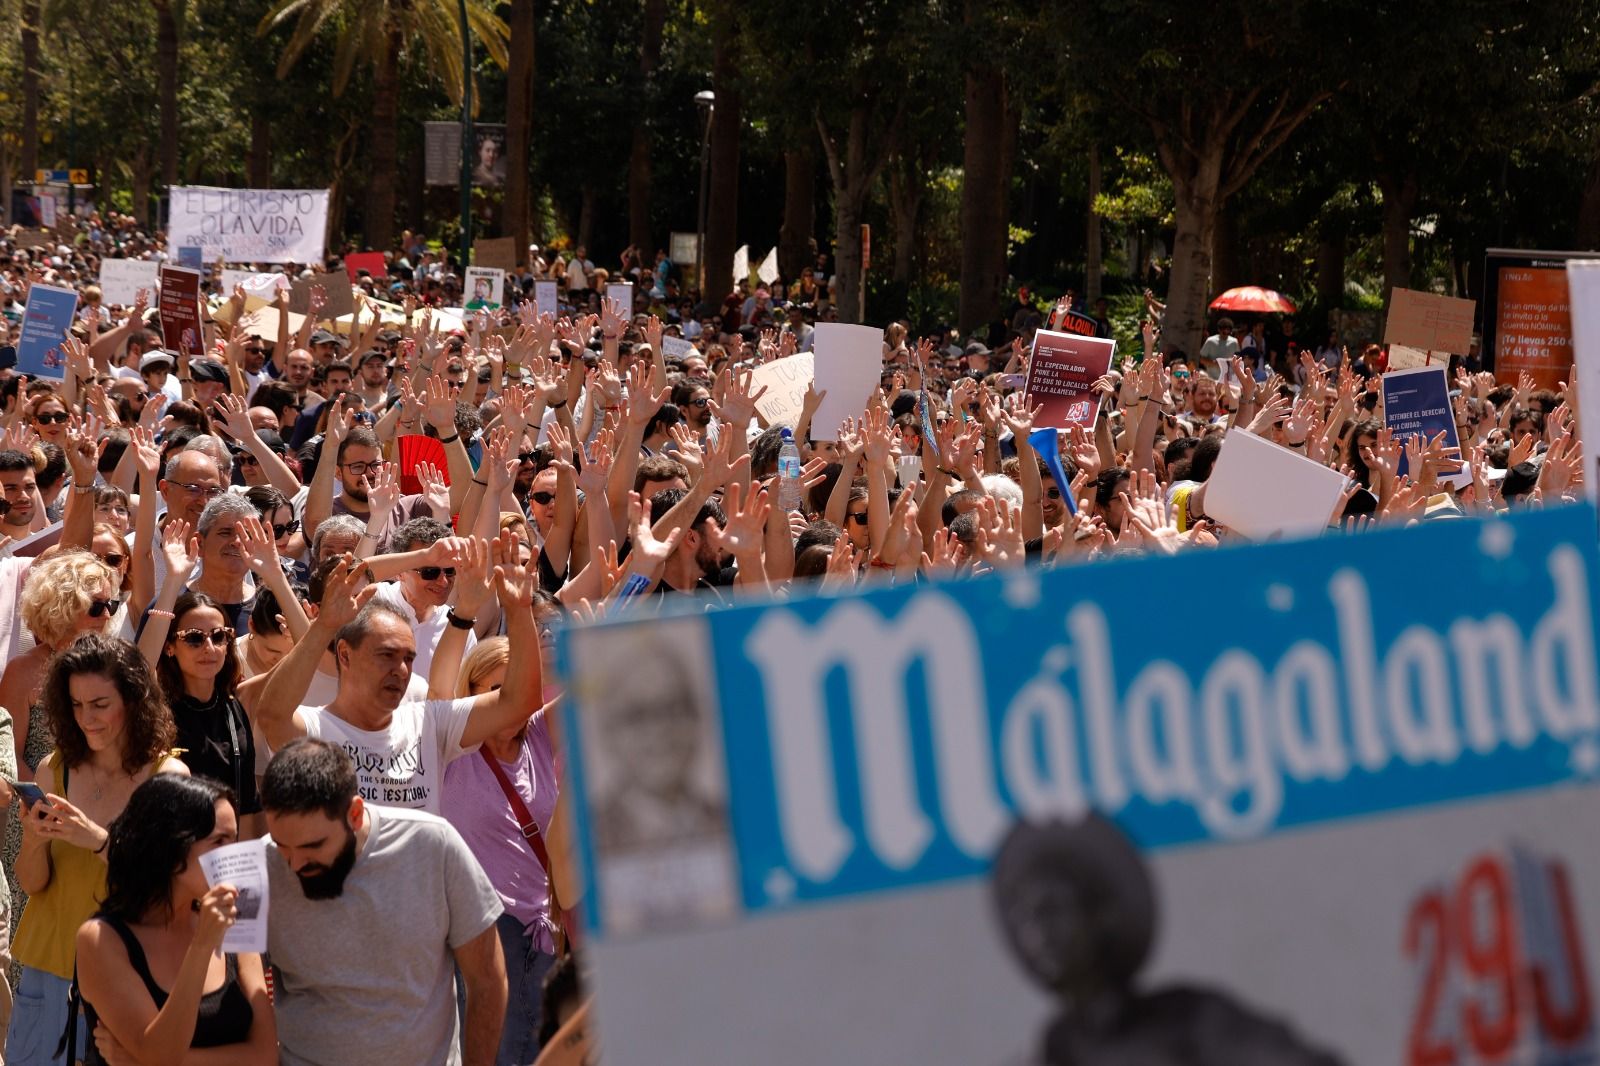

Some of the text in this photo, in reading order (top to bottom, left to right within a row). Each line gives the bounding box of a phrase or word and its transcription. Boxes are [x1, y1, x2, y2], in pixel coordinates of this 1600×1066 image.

[218, 190, 314, 215] TURISMO
[249, 215, 304, 235] VIDA
[267, 236, 287, 248] SIN
[1523, 304, 1546, 313] amigo
[1512, 312, 1533, 320] invita
[1502, 321, 1529, 330] Cuenta
[1518, 335, 1545, 345] llevas
[1547, 336, 1566, 346] 250
[1526, 348, 1538, 358] 50
[1034, 368, 1050, 377] PONE
[1051, 370, 1059, 378] LA
[1036, 360, 1086, 374] EL ESPECULADOR
[1033, 376, 1041, 384] EN
[1042, 378, 1054, 386] SUS
[1062, 380, 1089, 390] LOCALES
[1049, 386, 1077, 397] ALAMEDA
[763, 396, 788, 420] NOS
[1388, 412, 1413, 421] DEFENDER
[1421, 408, 1446, 417] DERECHO
[1400, 421, 1422, 430] CIUDAD:
[743, 543, 1598, 882] Málagaland
[359, 786, 378, 800] SIC
[1401, 853, 1594, 1066] 29J
